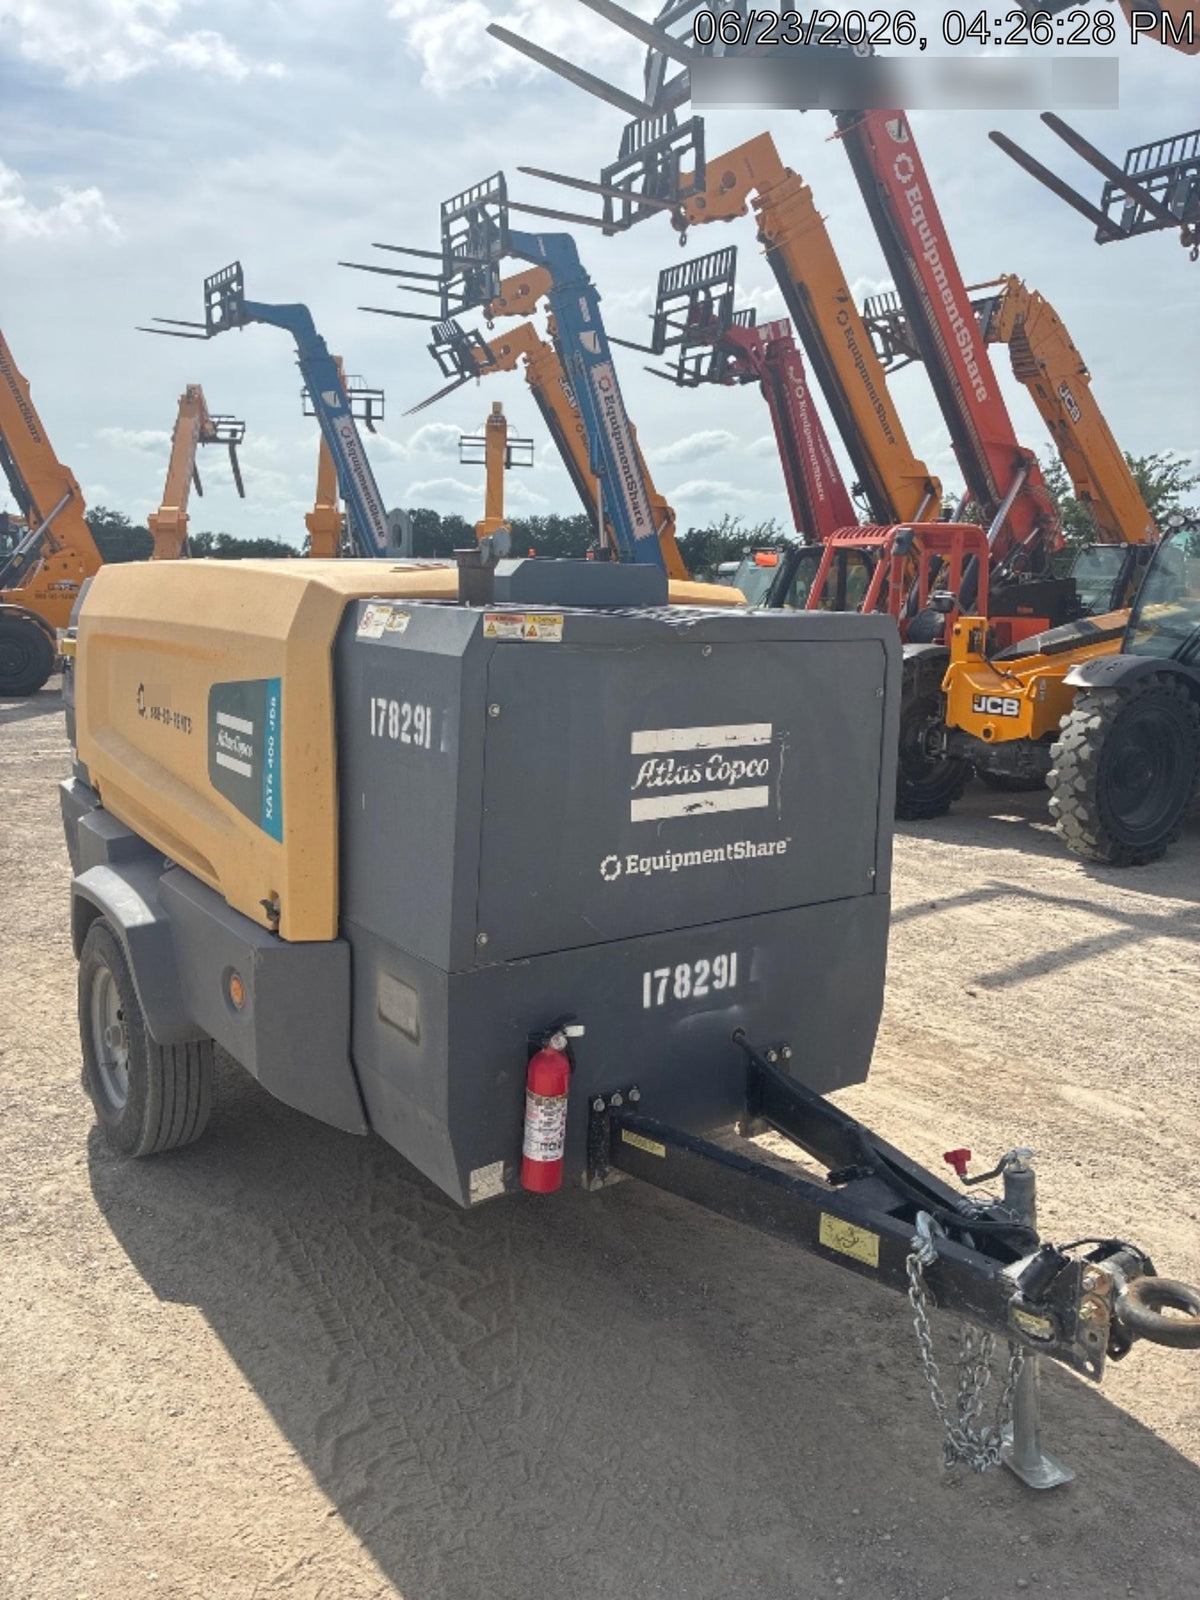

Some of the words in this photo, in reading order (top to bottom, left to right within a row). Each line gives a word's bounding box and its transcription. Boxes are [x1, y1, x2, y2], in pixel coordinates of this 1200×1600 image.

[904, 182, 988, 404] EquipmentShare
[1059, 384, 1080, 421] JCB
[604, 393, 645, 527] EquipmentShare
[370, 697, 432, 750] 178291
[973, 696, 1019, 715] JCB
[267, 735, 275, 768] 400
[631, 757, 702, 790] Atlas
[704, 753, 769, 786] Copco
[625, 840, 788, 876] EquipmentShare
[643, 951, 737, 1009] 178291
